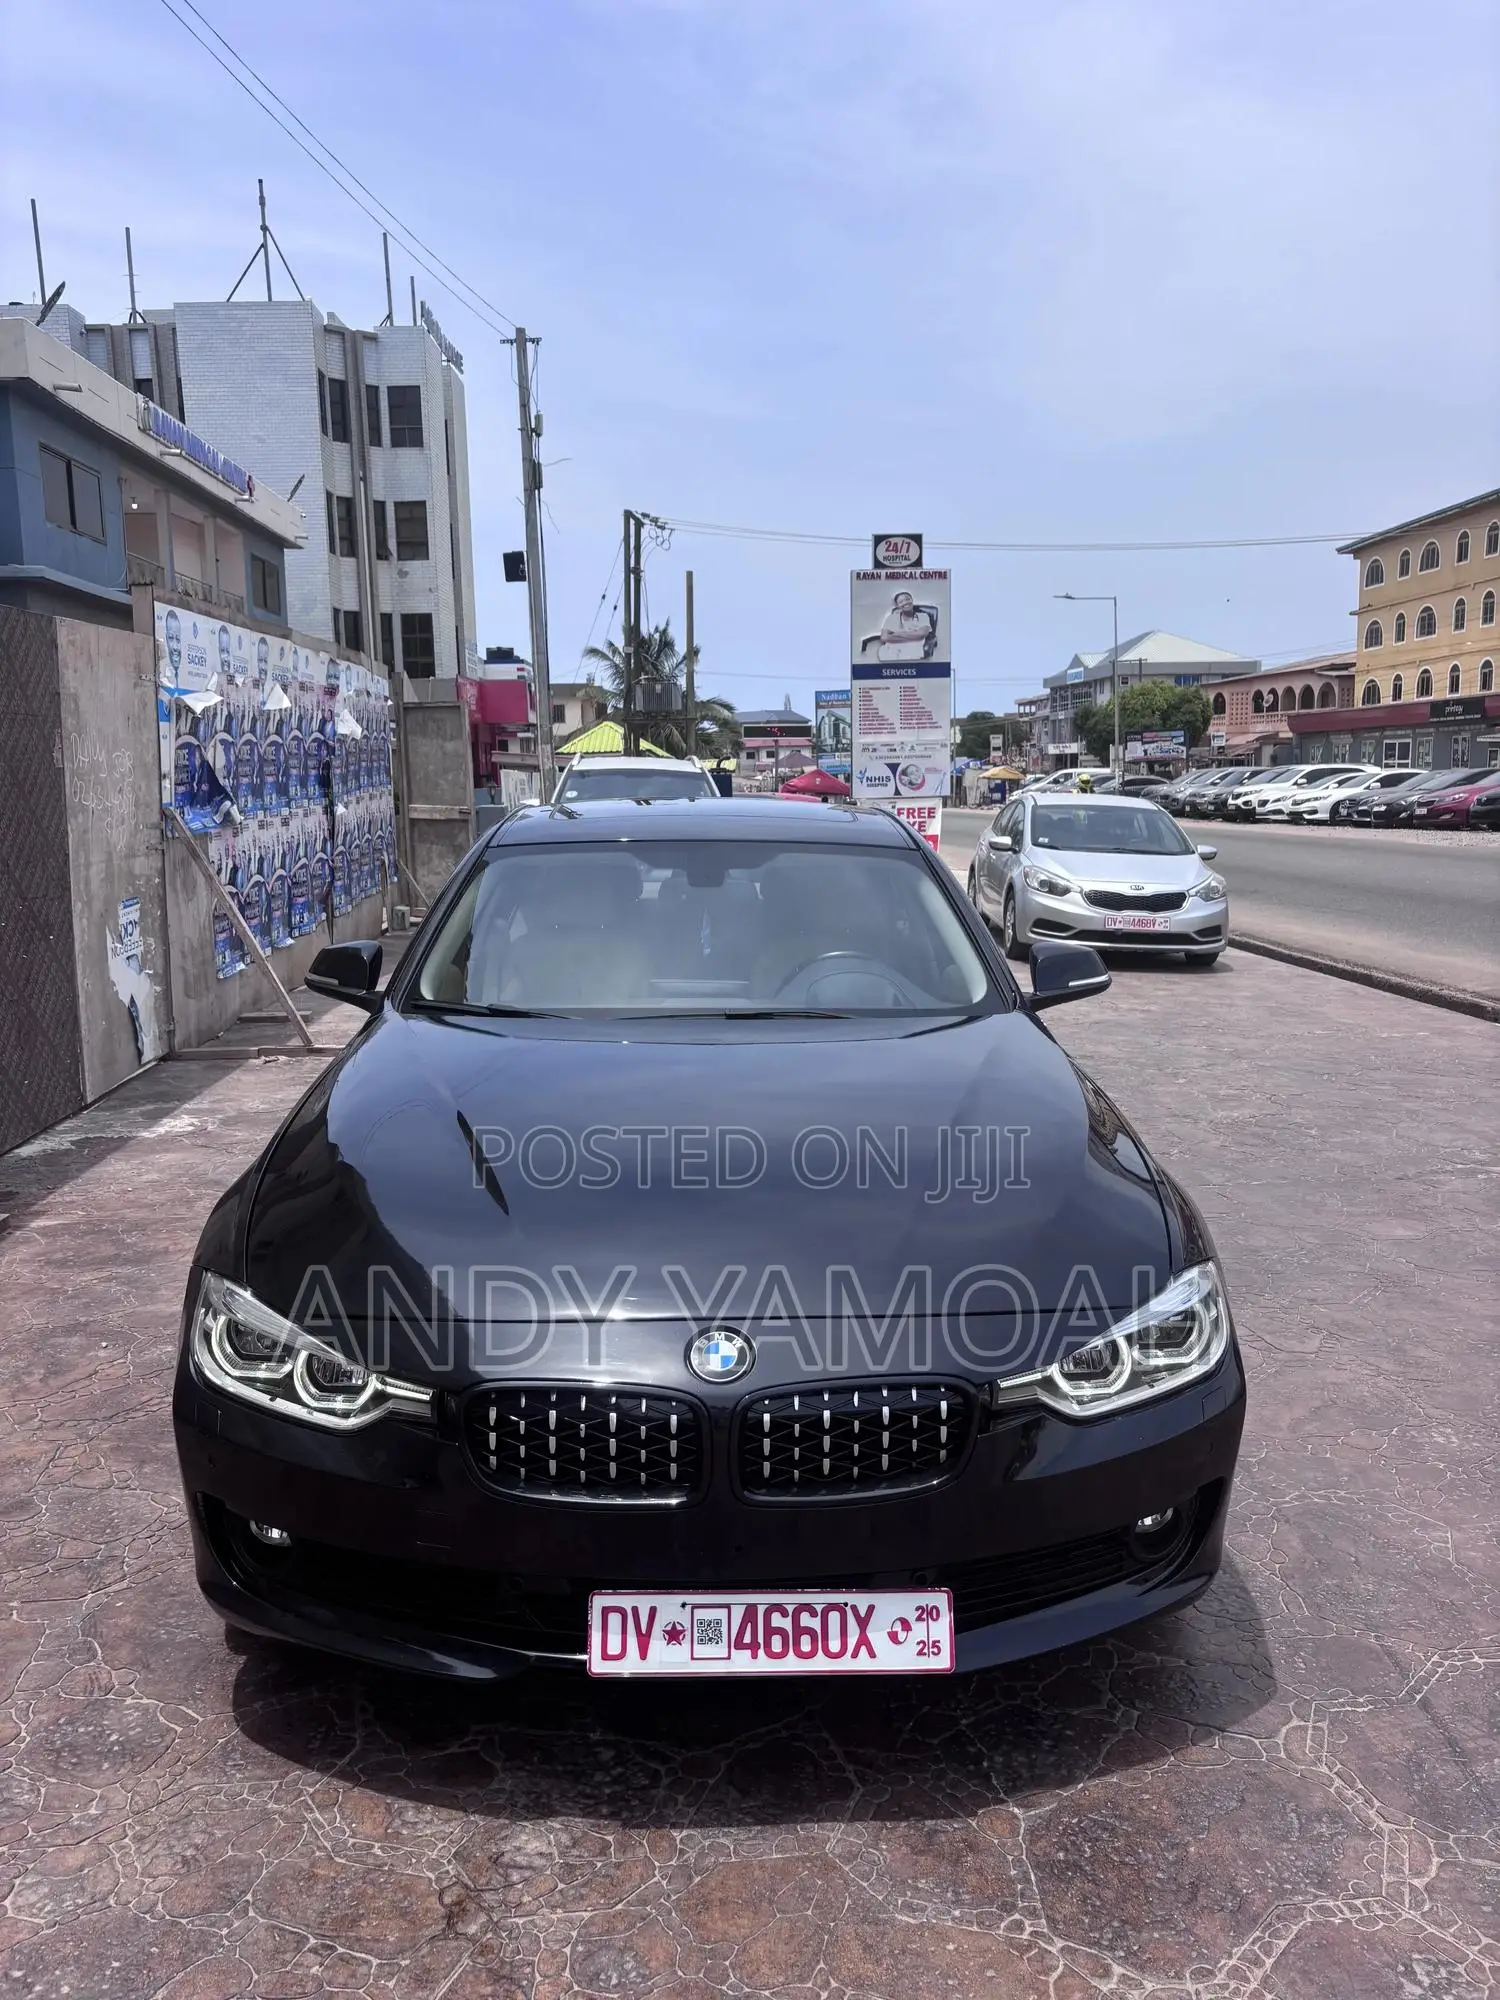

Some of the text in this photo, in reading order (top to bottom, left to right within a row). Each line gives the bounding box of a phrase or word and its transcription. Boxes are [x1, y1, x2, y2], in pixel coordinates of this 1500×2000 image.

[885, 540, 911, 553] 24/7
[856, 571, 948, 580] RAYAN MEDICAL CENTRE
[187, 653, 207, 668] SACKEY
[882, 668, 916, 676] SERVICES
[897, 807, 936, 819] FREE
[907, 821, 926, 832] YE
[1107, 917, 1117, 927] DV
[697, 1333, 743, 1349] BMW
[915, 1605, 940, 1621] 20
[600, 1603, 876, 1660] DV 4660X
[916, 1640, 941, 1656] 25
